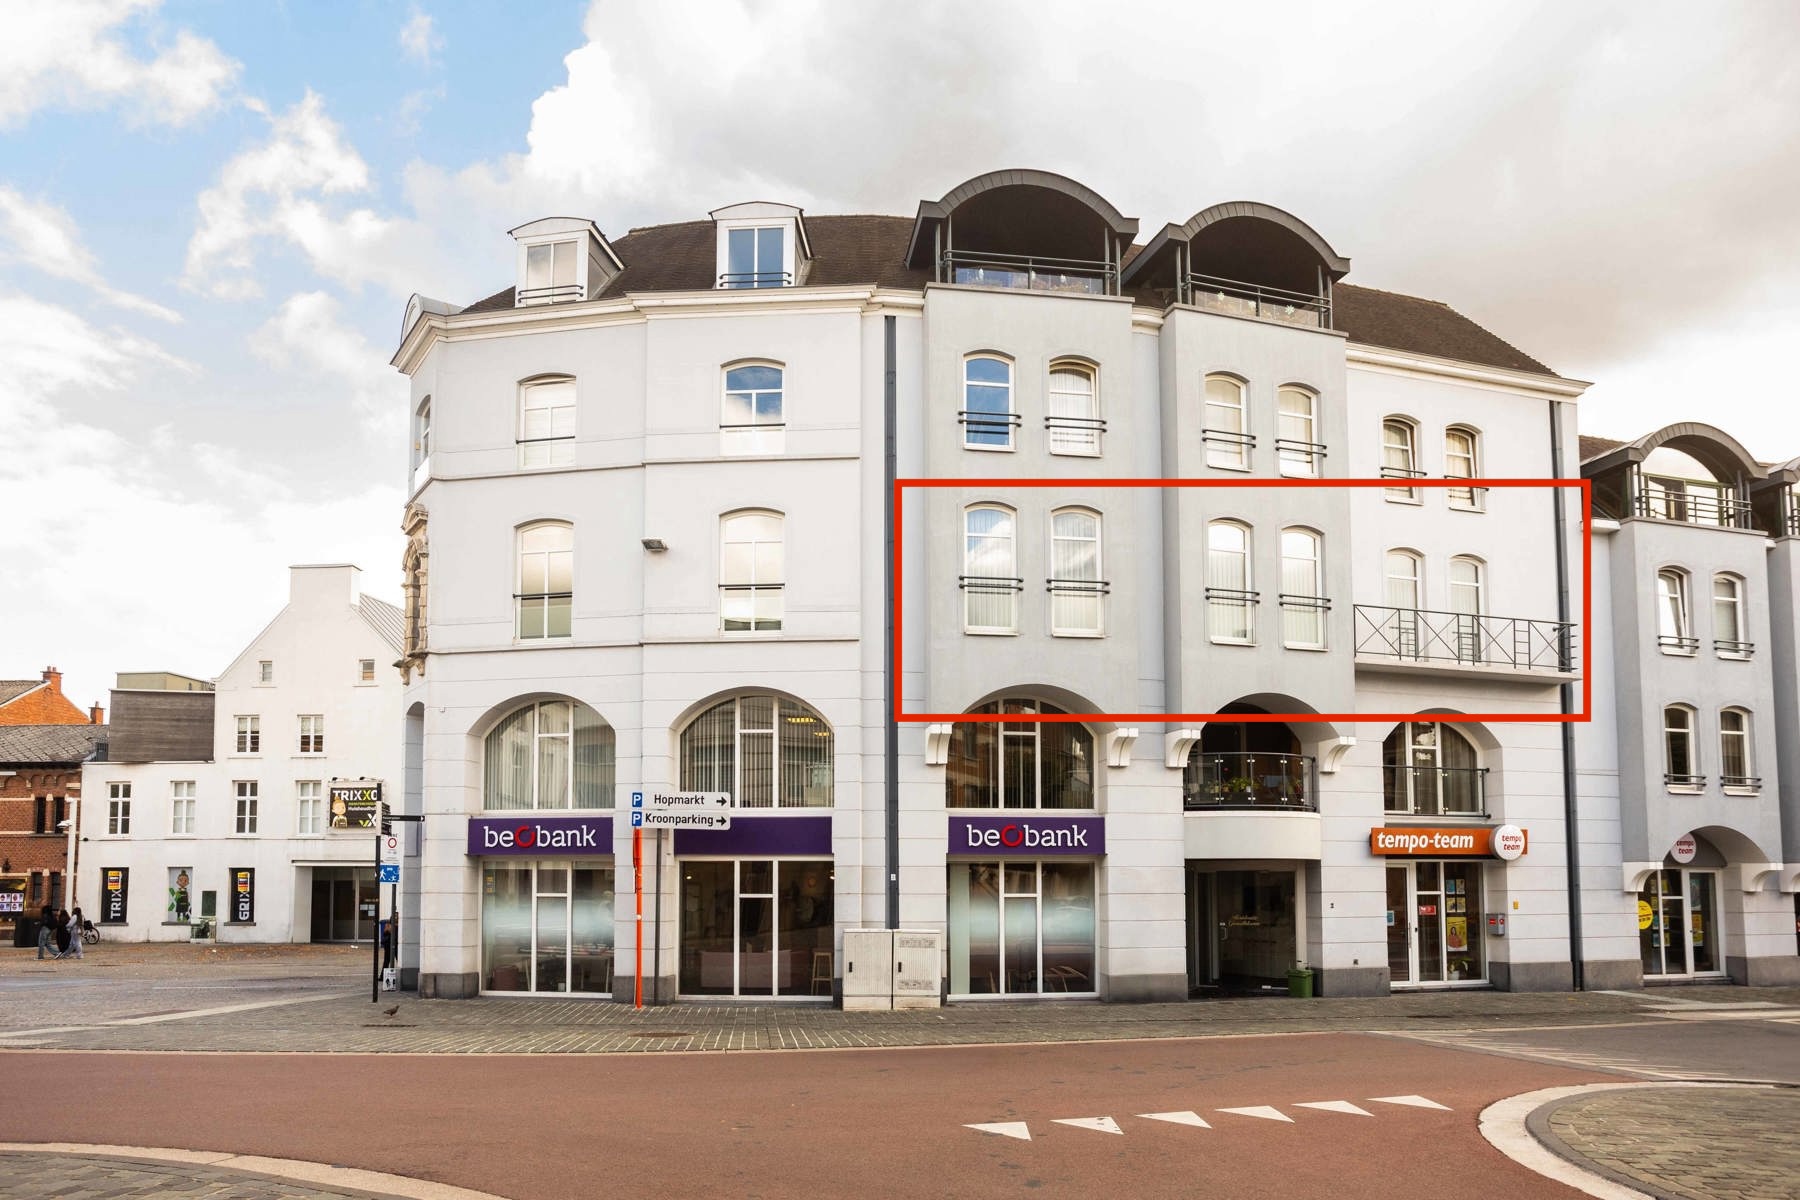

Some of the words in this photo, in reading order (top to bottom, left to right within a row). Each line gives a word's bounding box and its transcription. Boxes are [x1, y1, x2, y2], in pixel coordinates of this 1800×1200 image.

[633, 794, 641, 806] P
[654, 794, 705, 807] Hopmarkt
[632, 813, 641, 824] P
[645, 813, 714, 826] Kroonparking
[1377, 832, 1474, 853] tempo-team
[1501, 834, 1522, 844] tempo
[1503, 843, 1521, 851] team
